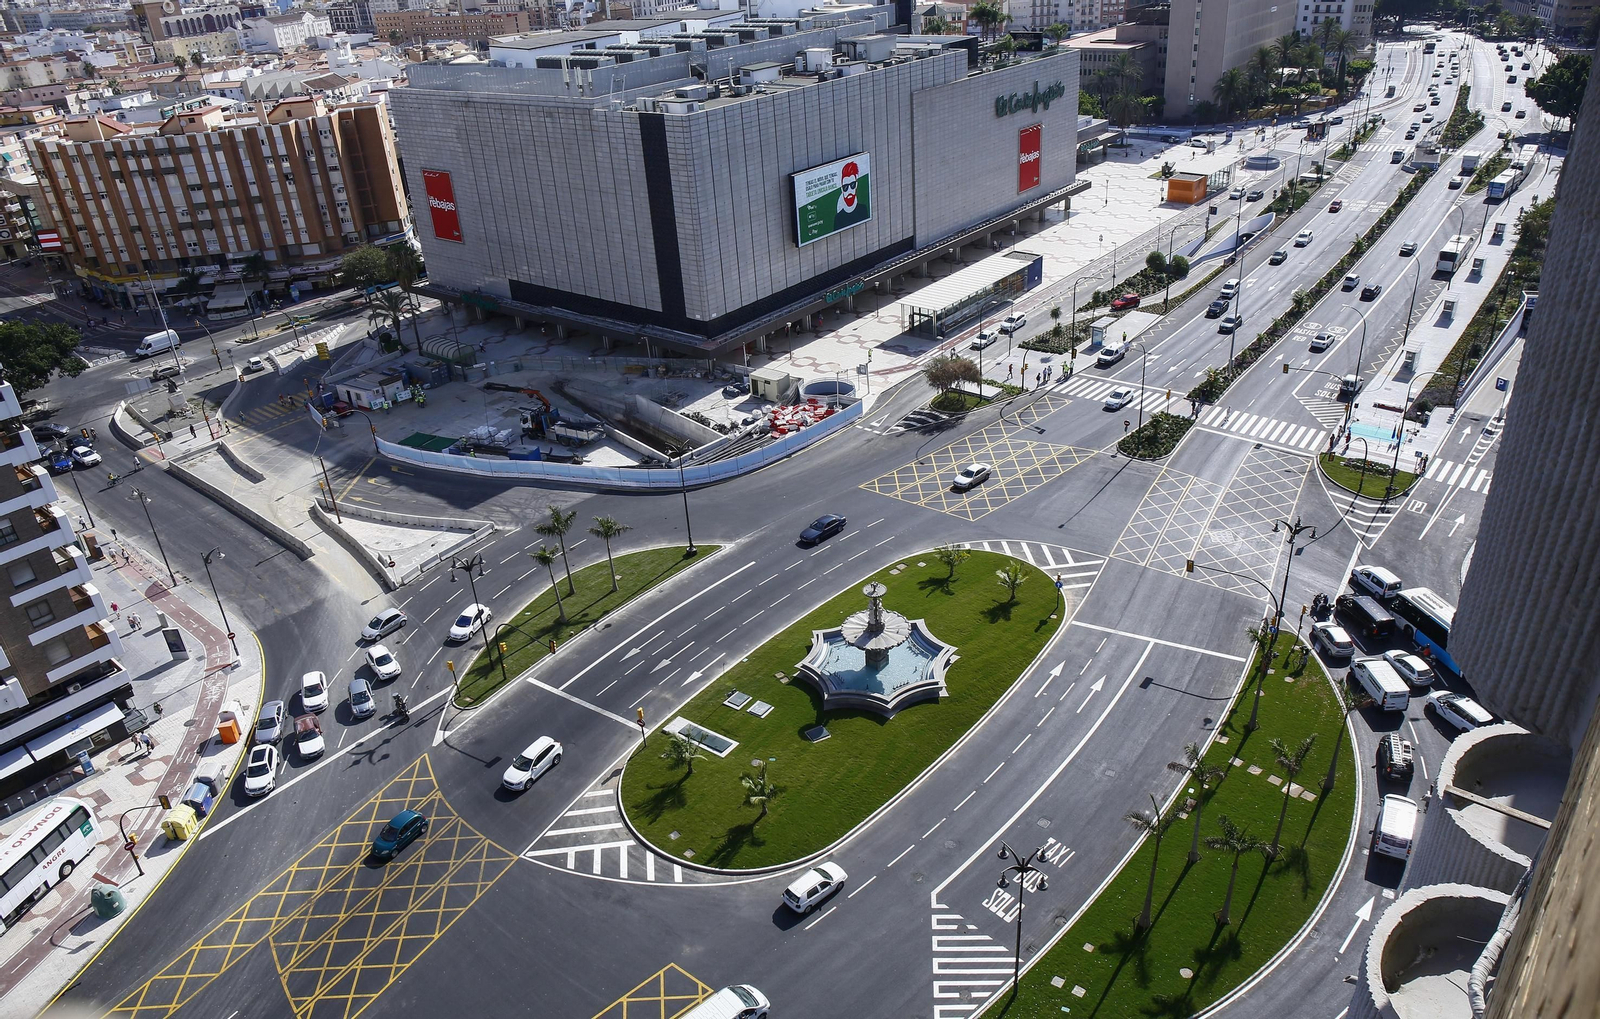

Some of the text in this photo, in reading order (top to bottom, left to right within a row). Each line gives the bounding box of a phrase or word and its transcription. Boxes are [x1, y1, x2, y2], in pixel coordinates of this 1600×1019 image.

[996, 79, 1065, 118] El Corte Inglés
[1020, 150, 1039, 164] rebajas
[430, 198, 455, 211] rebajas
[1324, 382, 1341, 391] BUS
[1498, 379, 1504, 387] P
[1314, 389, 1338, 399] SOLO
[1037, 837, 1076, 868] TAXI
